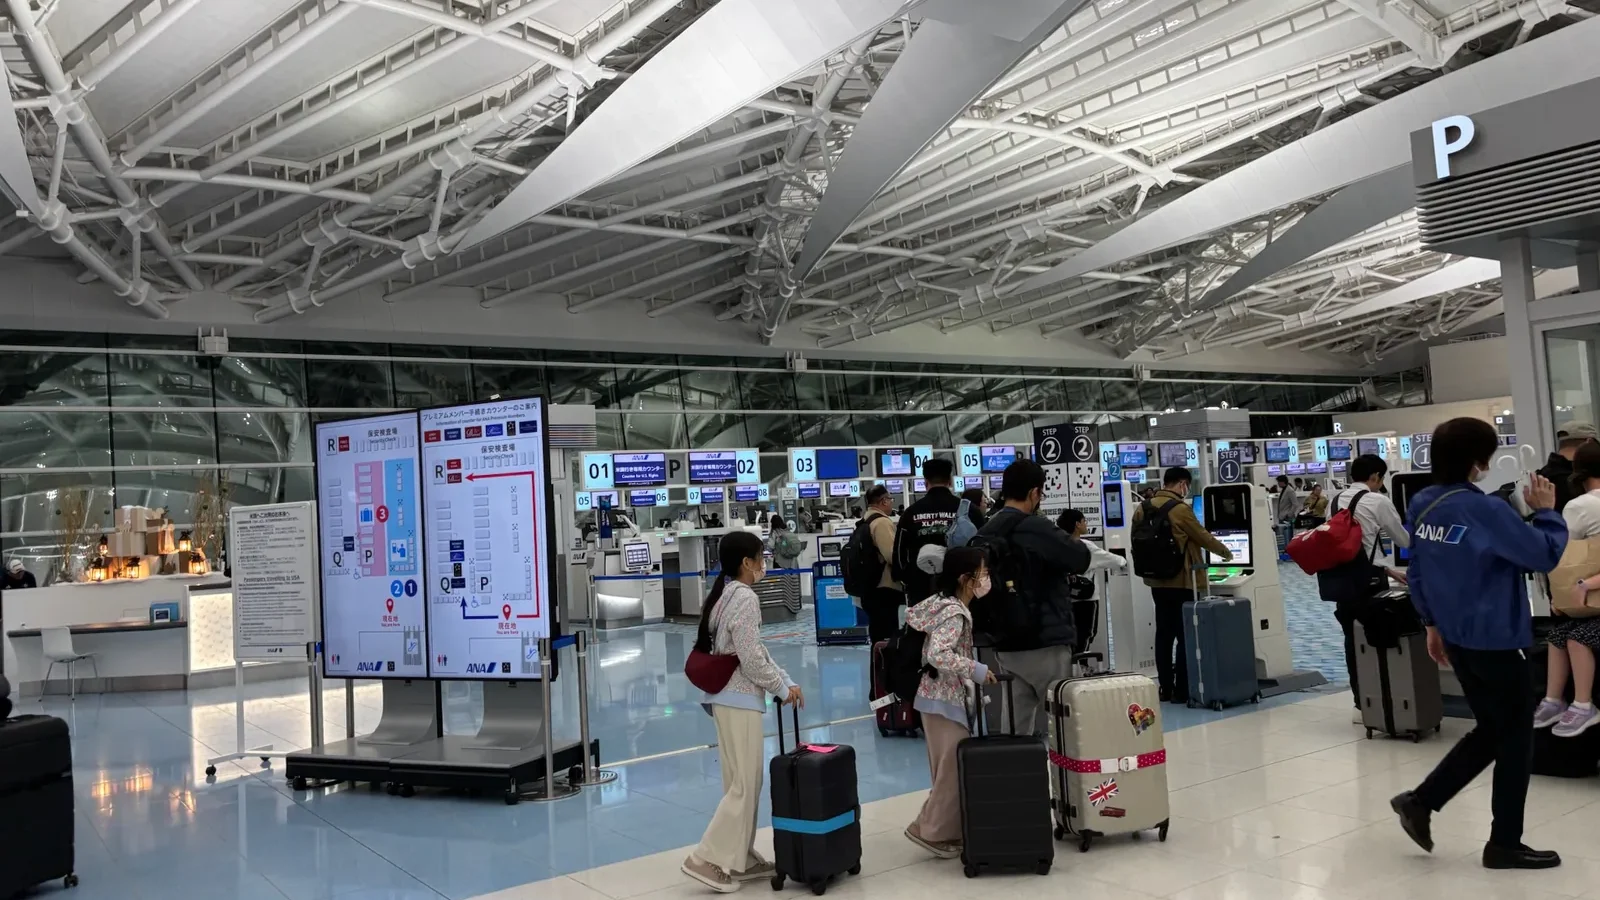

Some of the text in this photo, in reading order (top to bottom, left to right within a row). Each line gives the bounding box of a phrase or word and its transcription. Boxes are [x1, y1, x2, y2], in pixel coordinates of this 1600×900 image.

[1431, 114, 1475, 180] P
[368, 427, 398, 437] 保安検査場
[1042, 427, 1058, 436] STEP
[1074, 426, 1090, 434] STEP
[1333, 422, 1342, 433] R
[327, 438, 336, 452] R
[481, 443, 515, 454] 保安検査場
[1045, 441, 1057, 459] 2
[1077, 438, 1089, 456] 2
[1318, 445, 1326, 456] 11
[1402, 443, 1410, 454] 13
[964, 453, 978, 467] 05
[1186, 448, 1196, 460] 08
[1220, 451, 1238, 460] STEP
[1420, 447, 1430, 465] 1
[668, 459, 682, 479] P
[737, 459, 755, 474] 02
[796, 458, 813, 472] 03
[859, 455, 869, 472] P
[435, 464, 444, 479] R
[588, 463, 609, 479] 01
[1225, 463, 1234, 479] 1
[850, 484, 858, 493] 10
[956, 480, 963, 488] 13
[656, 493, 667, 502] 06
[689, 492, 700, 500] 07
[758, 488, 767, 497] 08
[1082, 490, 1099, 498] Express
[578, 496, 590, 506] 05
[913, 511, 957, 521] LIBERTY WALK
[1415, 522, 1444, 543] ANA
[332, 551, 342, 568] Q
[365, 549, 373, 563] P
[440, 576, 451, 594] Q
[480, 576, 489, 591] P
[497, 622, 517, 630] 現在地
[356, 661, 375, 672] ANA
[466, 662, 487, 674] ANA
